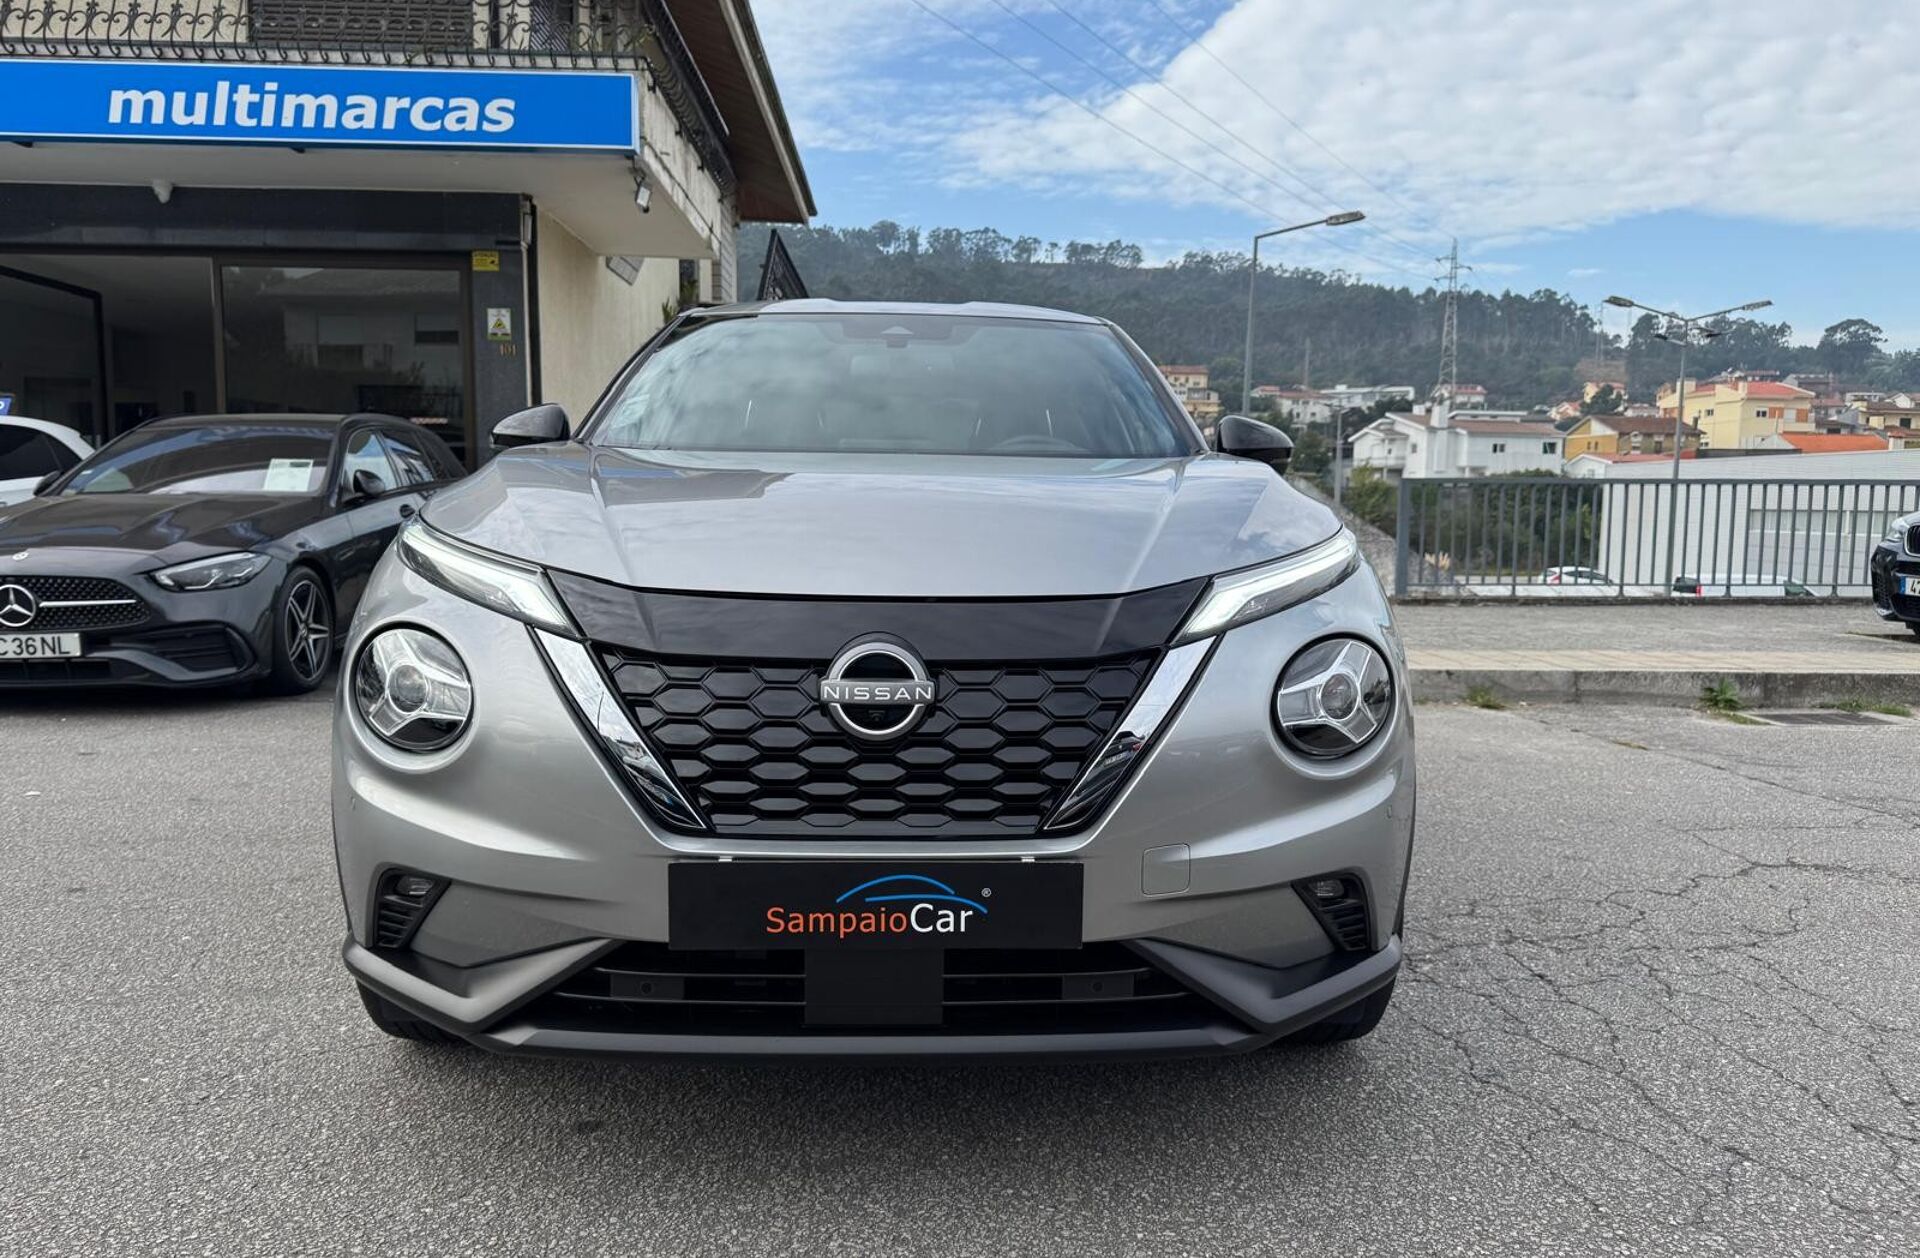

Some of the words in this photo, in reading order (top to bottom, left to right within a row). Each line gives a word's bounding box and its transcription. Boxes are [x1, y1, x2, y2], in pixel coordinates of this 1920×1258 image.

[107, 80, 516, 133] multimarcas
[823, 686, 932, 701] NISSAN
[765, 903, 974, 939] SampaioCar
